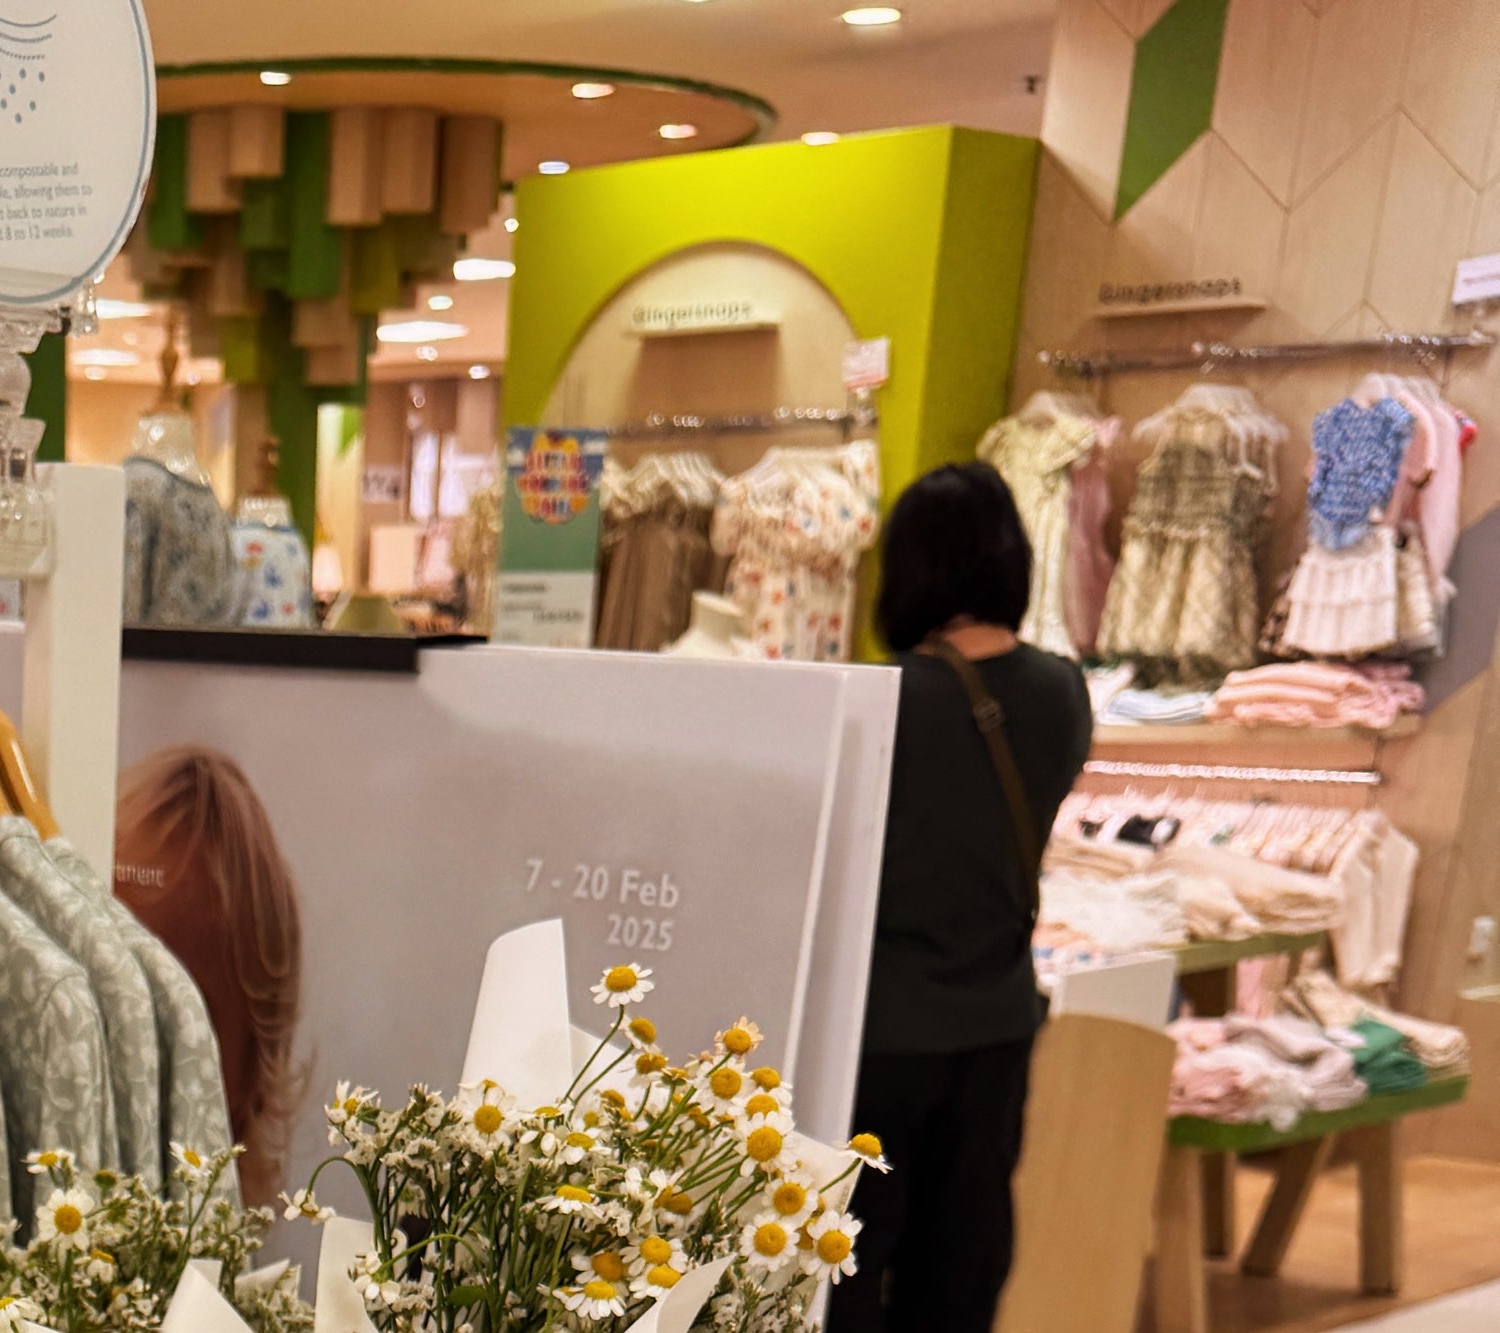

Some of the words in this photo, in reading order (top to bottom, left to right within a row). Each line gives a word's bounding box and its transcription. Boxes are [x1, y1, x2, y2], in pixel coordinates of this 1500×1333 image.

[0, 162, 58, 179] compostable
[62, 162, 79, 176] and
[14, 184, 54, 201] allowing
[55, 184, 80, 197] them
[81, 184, 93, 196] to
[6, 204, 29, 220] back
[31, 207, 43, 219] to
[14, 228, 26, 241] to
[28, 225, 41, 240] 12
[525, 859, 544, 892] 7
[574, 864, 609, 901] 20
[619, 869, 680, 909] Feb
[605, 914, 675, 952] 2025
